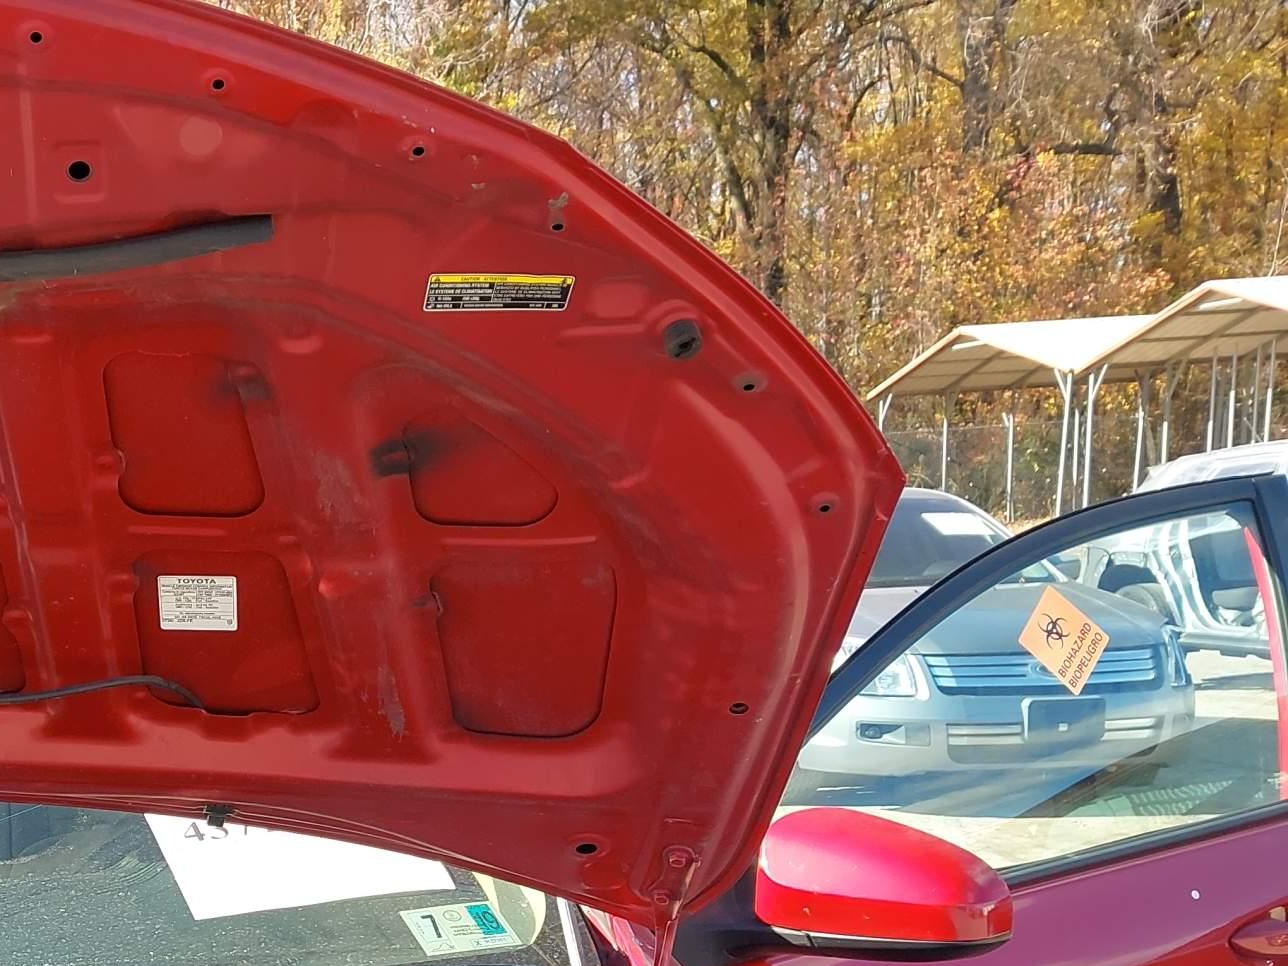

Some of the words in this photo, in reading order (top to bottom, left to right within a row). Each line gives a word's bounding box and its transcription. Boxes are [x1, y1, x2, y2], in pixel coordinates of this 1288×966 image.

[1058, 622, 1092, 678] BIOHAZARD
[1069, 632, 1103, 688] BIOPELIGRO
[420, 914, 442, 939] 7
